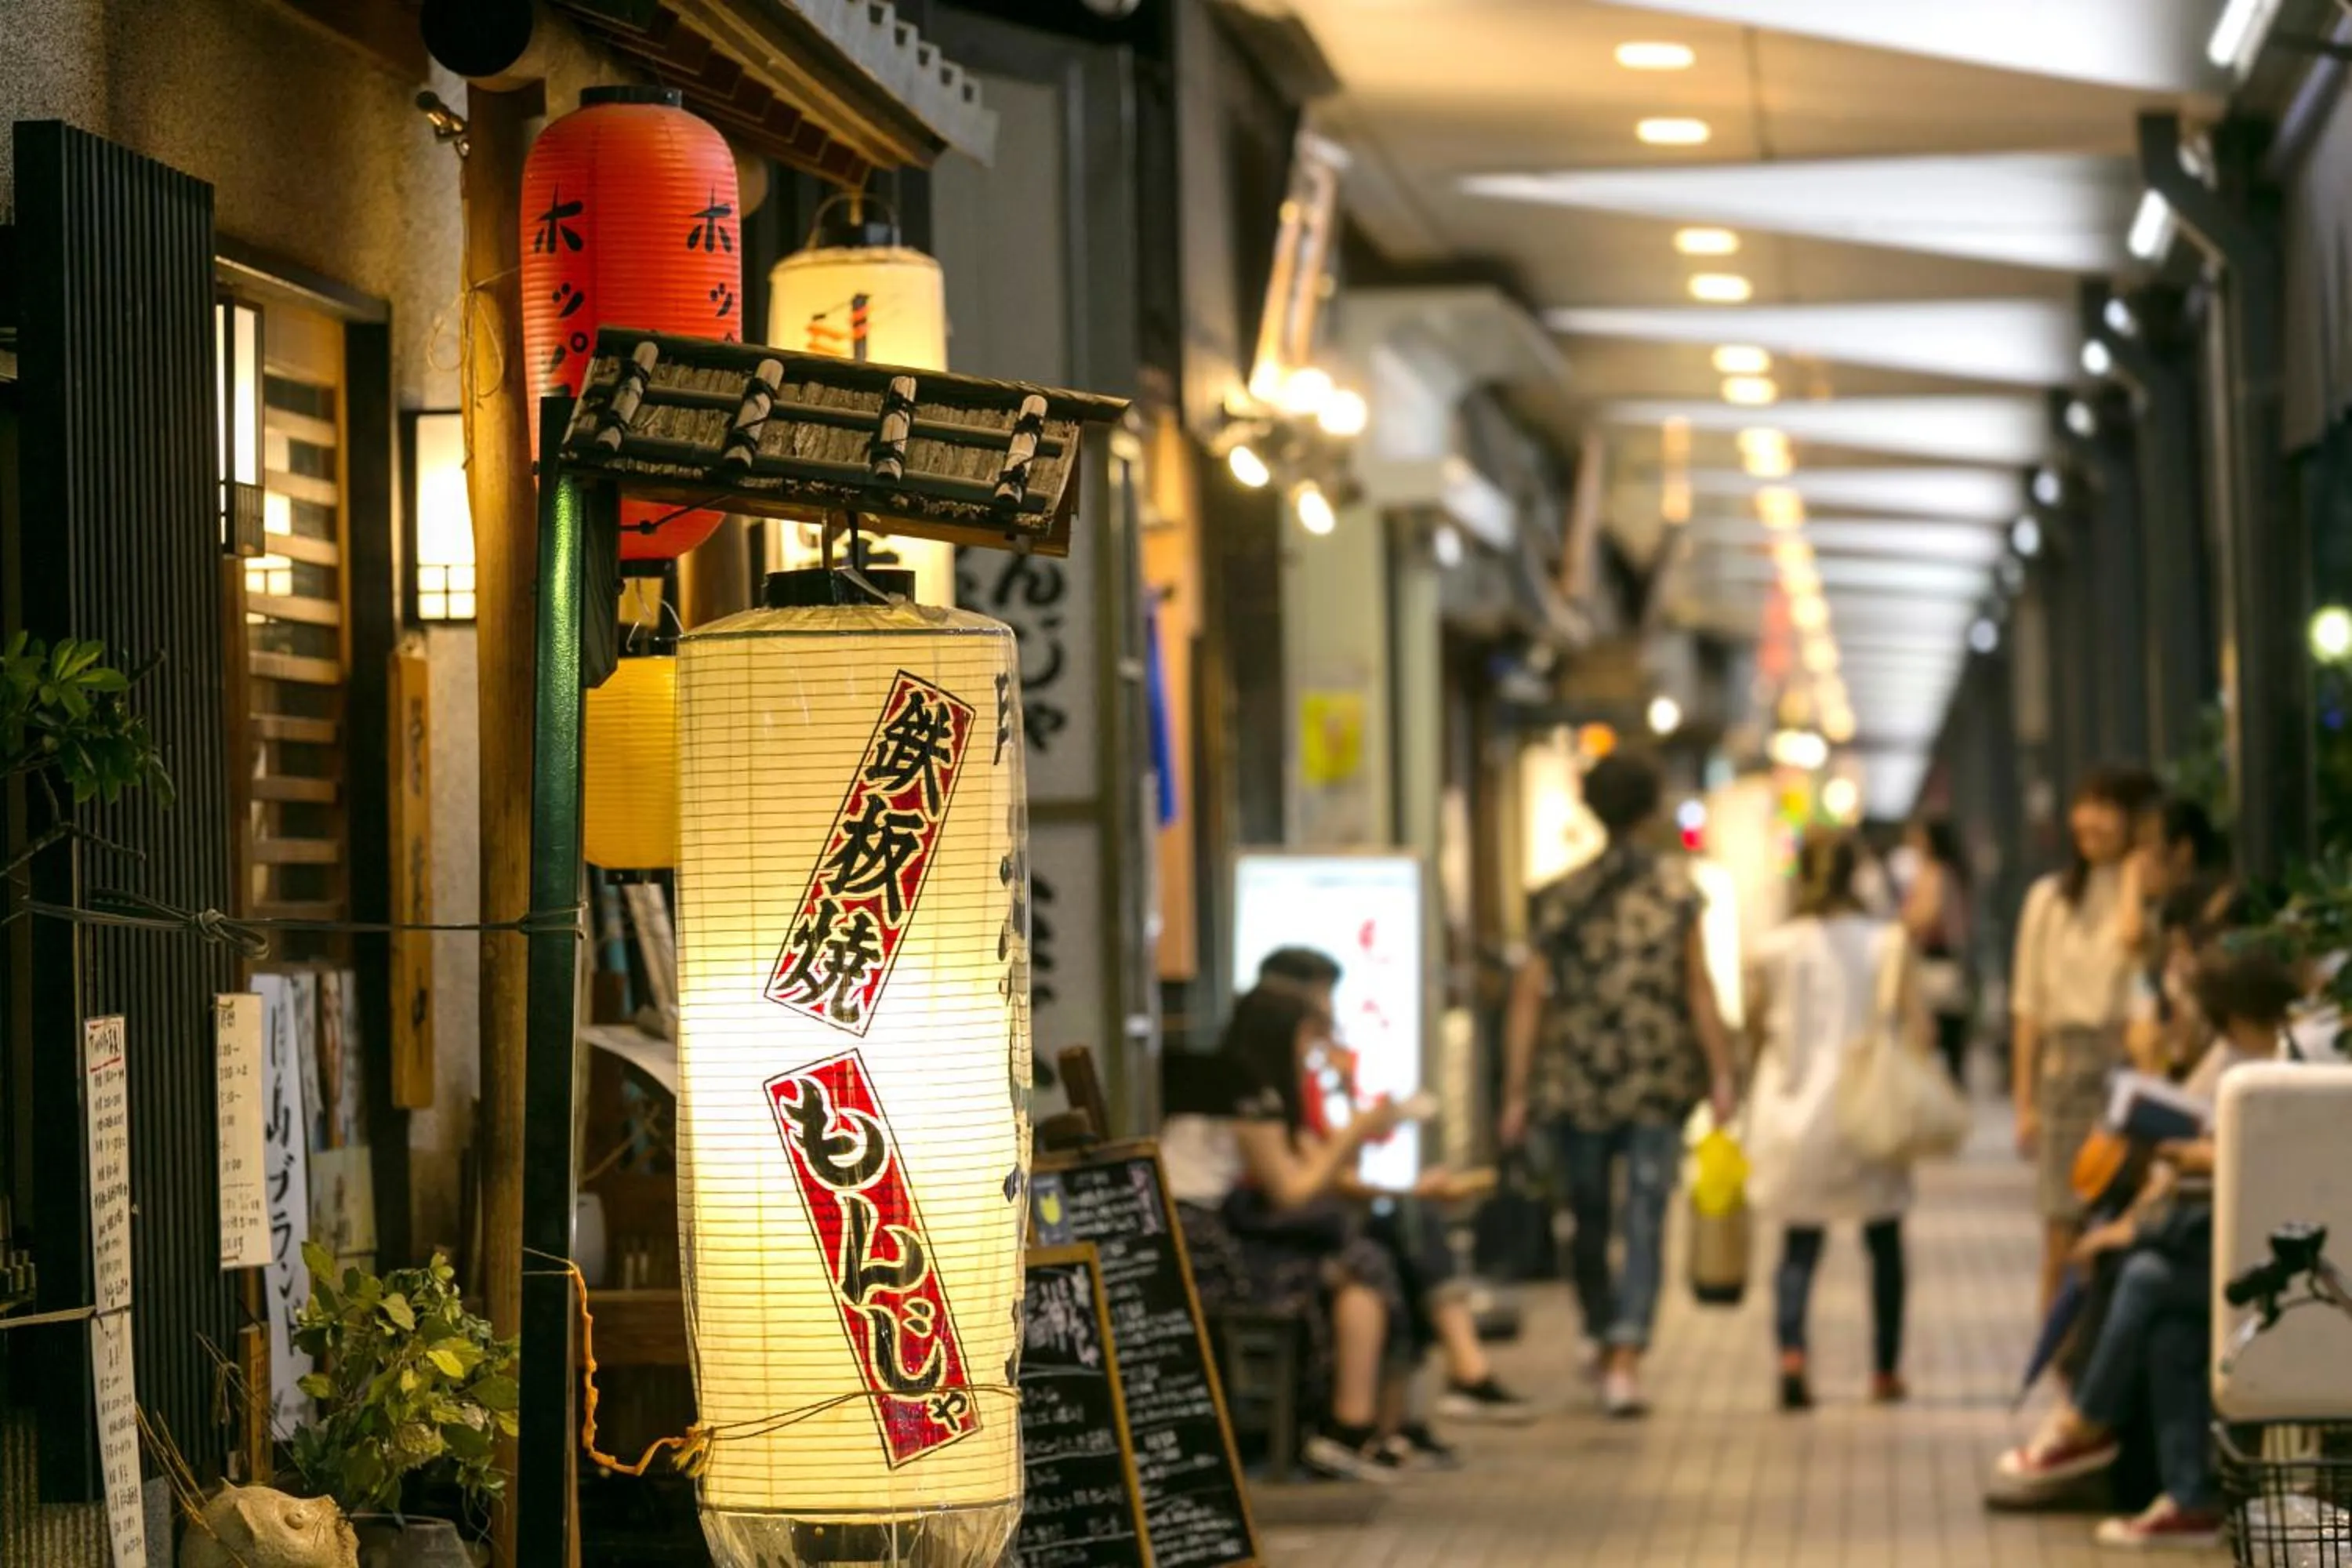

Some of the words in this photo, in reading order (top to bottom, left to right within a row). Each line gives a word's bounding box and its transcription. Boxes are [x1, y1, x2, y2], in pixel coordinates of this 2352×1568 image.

[687, 185, 734, 342] ホッ
[784, 691, 952, 1023] 鉄板焼
